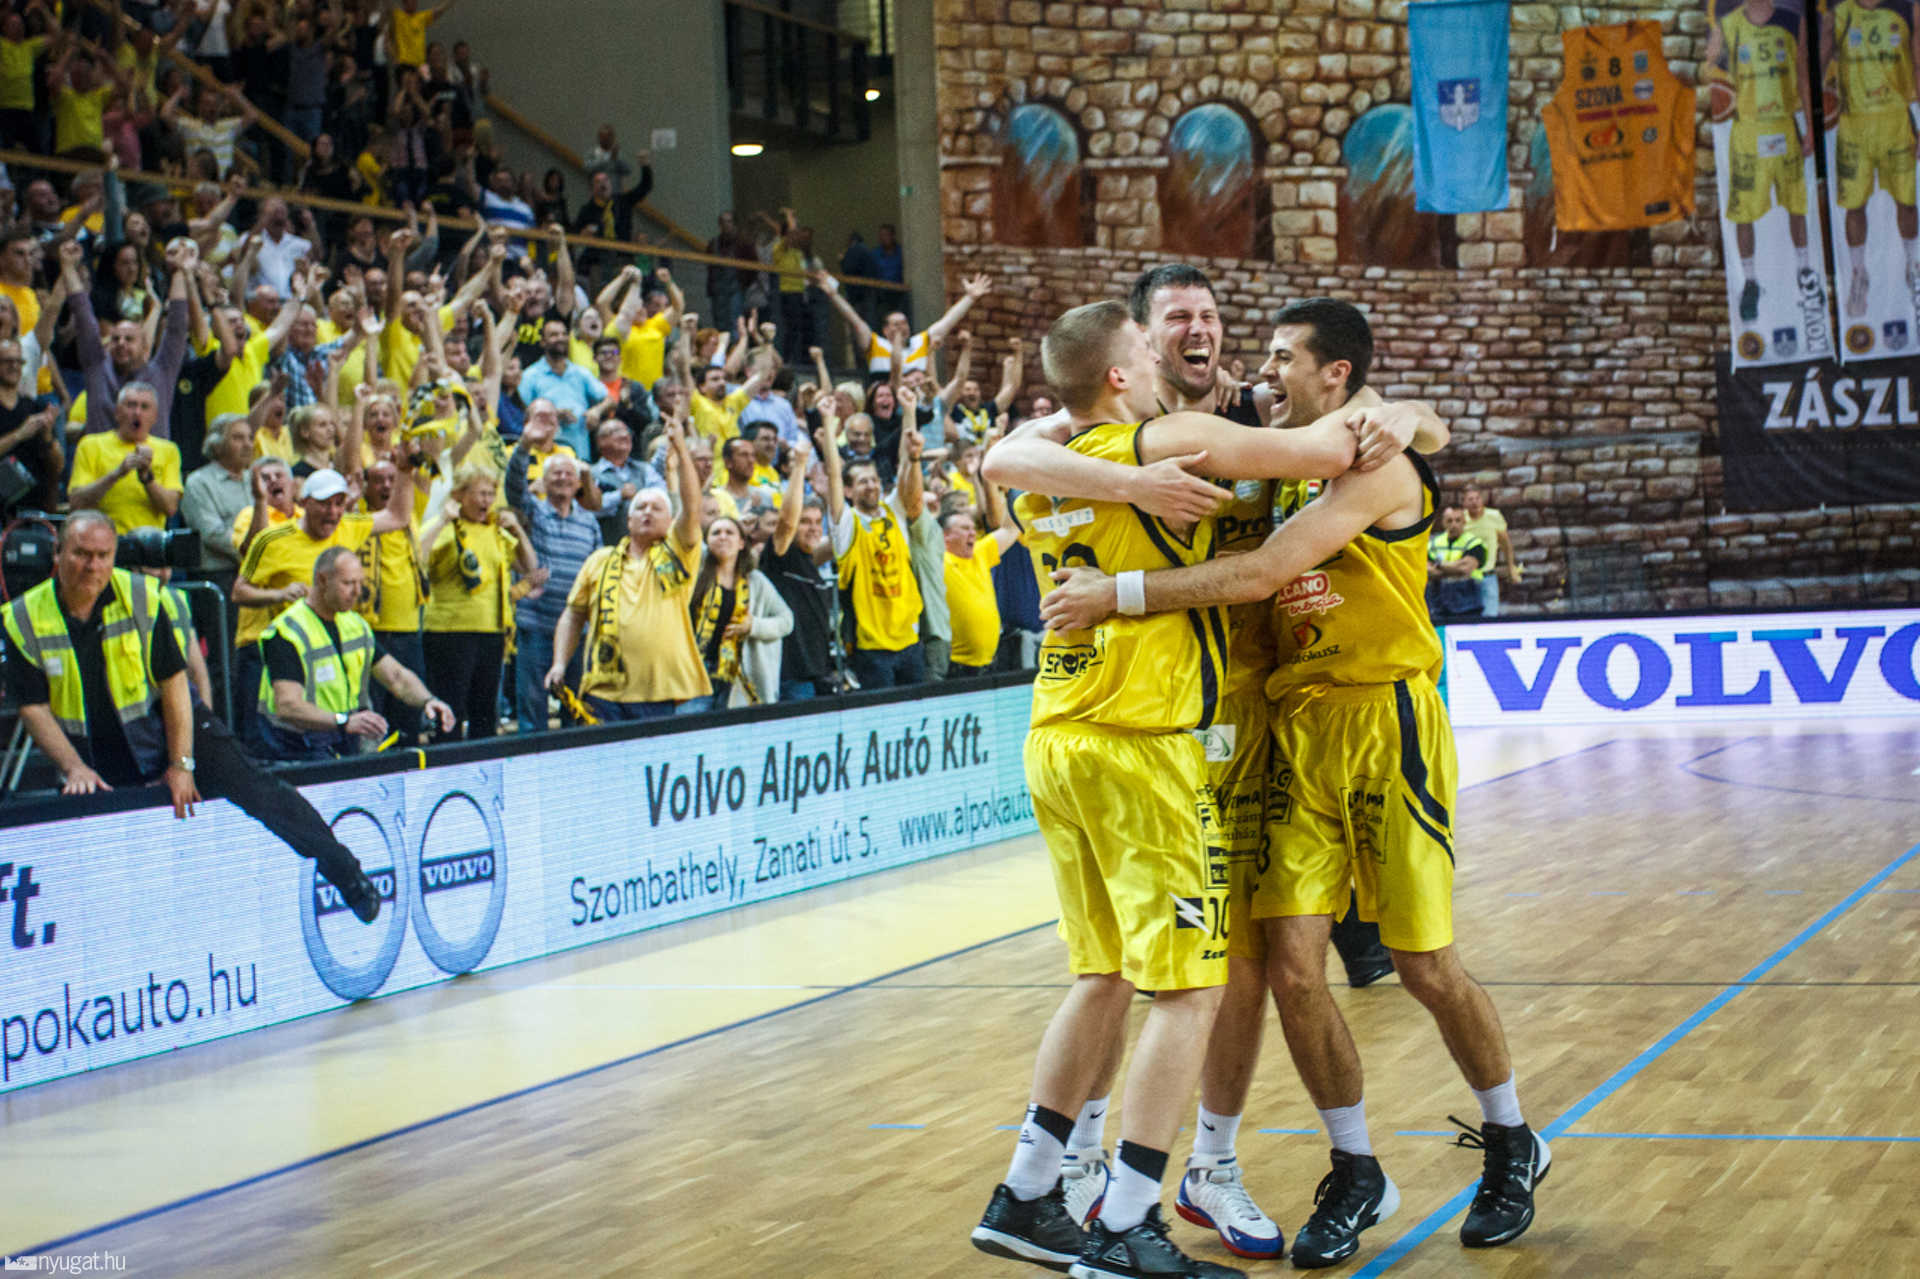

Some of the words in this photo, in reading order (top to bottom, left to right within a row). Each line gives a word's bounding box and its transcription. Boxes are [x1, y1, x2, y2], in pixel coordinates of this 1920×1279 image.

[1609, 56, 1621, 77] 8
[1762, 366, 1919, 430] ZÁSZL
[645, 754, 746, 827] Volvo
[758, 733, 852, 814] Alpok
[862, 718, 931, 787] Autó
[941, 713, 989, 772] Kft.
[423, 854, 493, 888] VOLVO
[571, 845, 745, 927] Szombathely,
[754, 831, 821, 884] Zanati
[830, 819, 851, 865] út
[859, 815, 879, 858] 5.
[1, 952, 257, 1082] pokauto.hu
